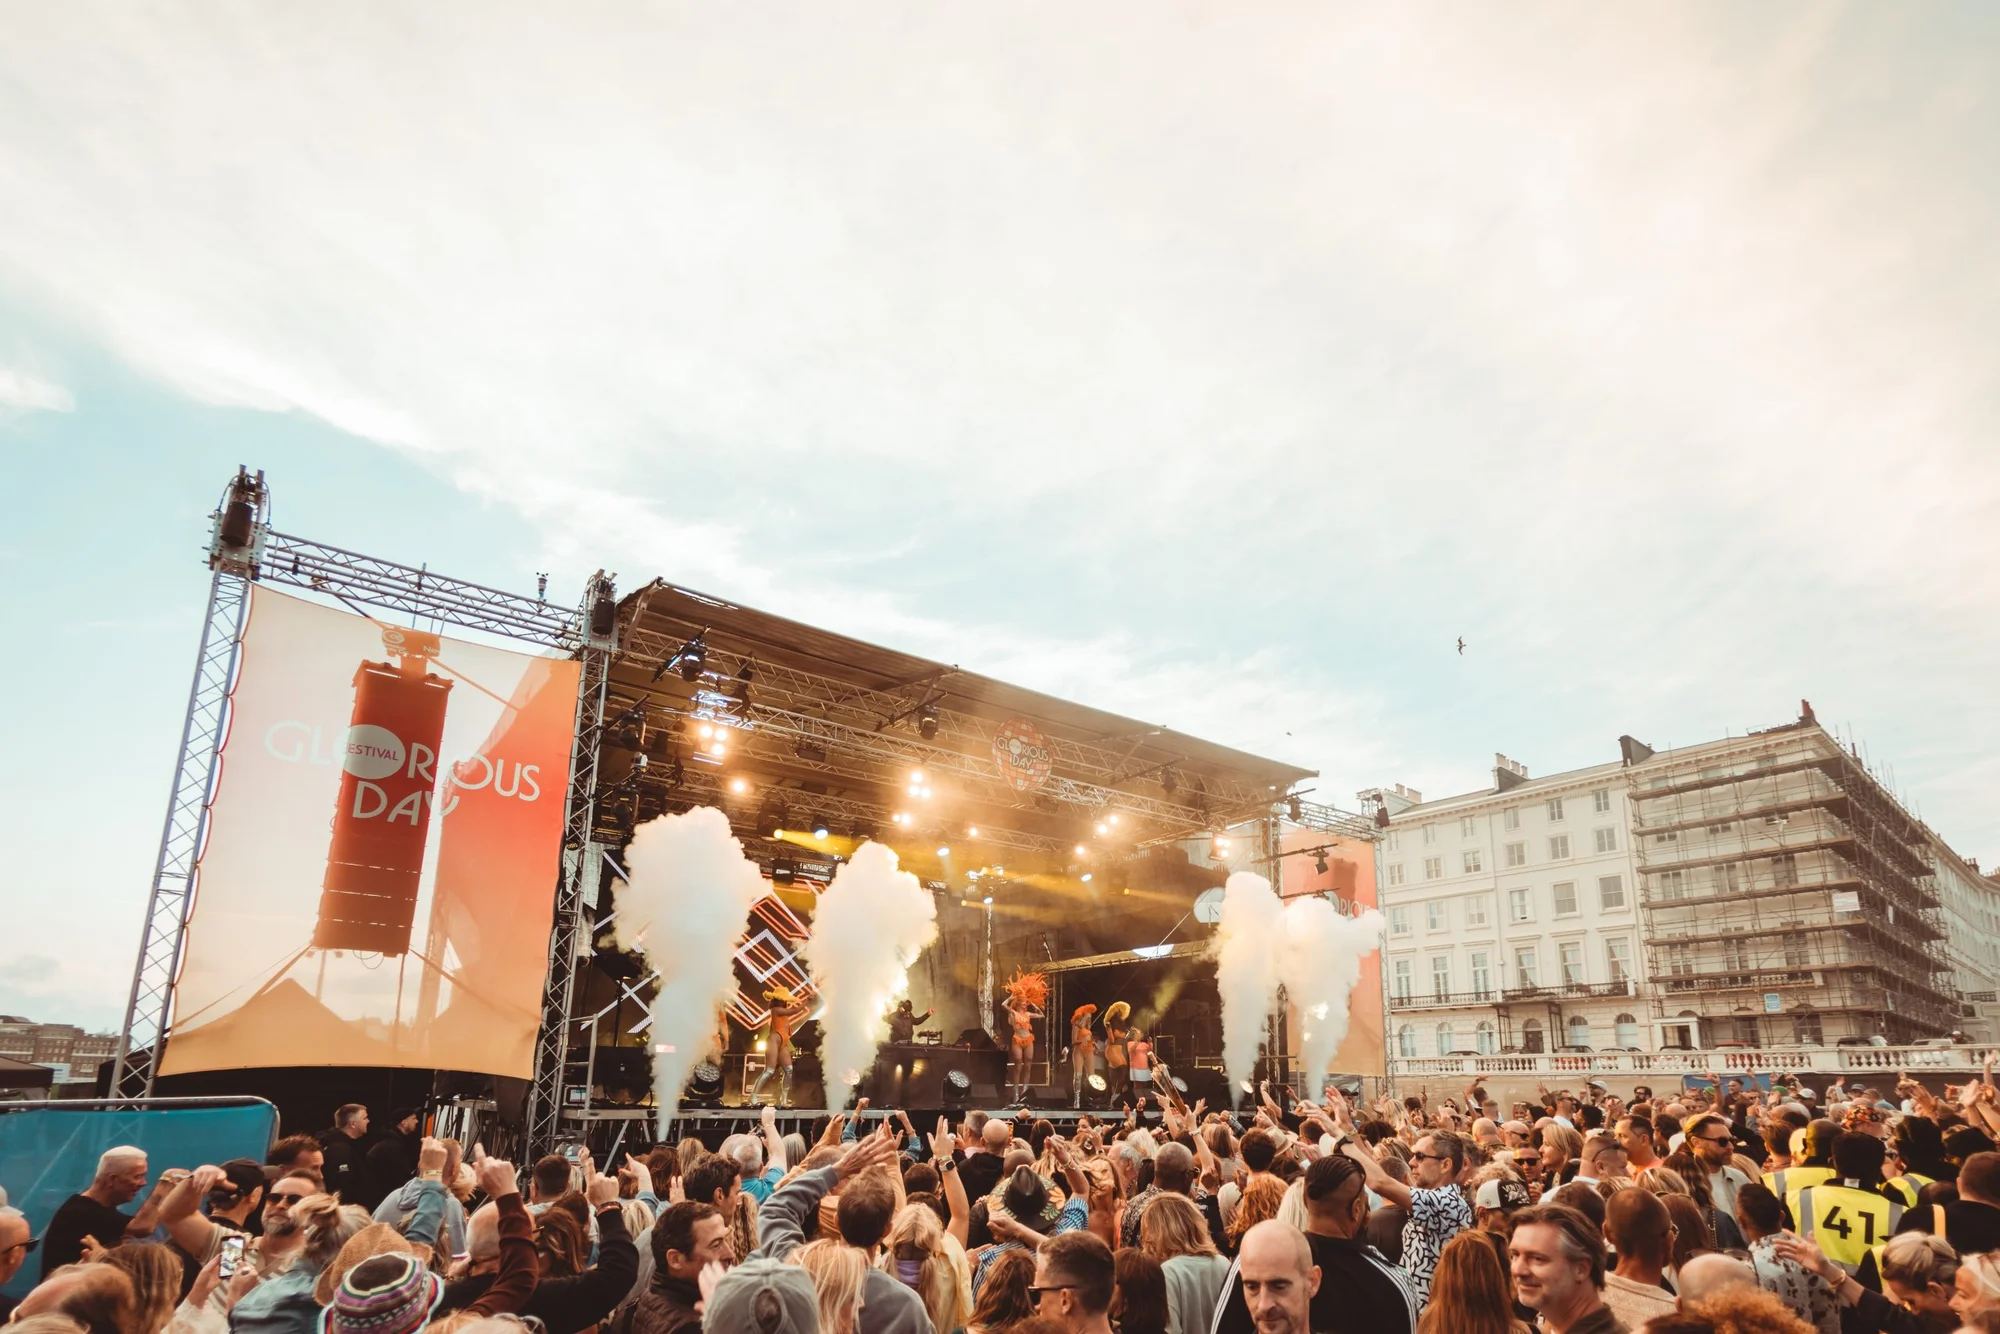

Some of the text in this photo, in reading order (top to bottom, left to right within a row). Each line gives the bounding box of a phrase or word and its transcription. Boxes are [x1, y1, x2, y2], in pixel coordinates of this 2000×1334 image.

[264, 720, 540, 802] GLOROUS
[346, 743, 398, 761] ESTIVAL
[997, 737, 1048, 761] GLORIOUS
[1012, 754, 1033, 768] DAY
[352, 781, 460, 826] DAY
[1823, 1206, 1874, 1245] 41
